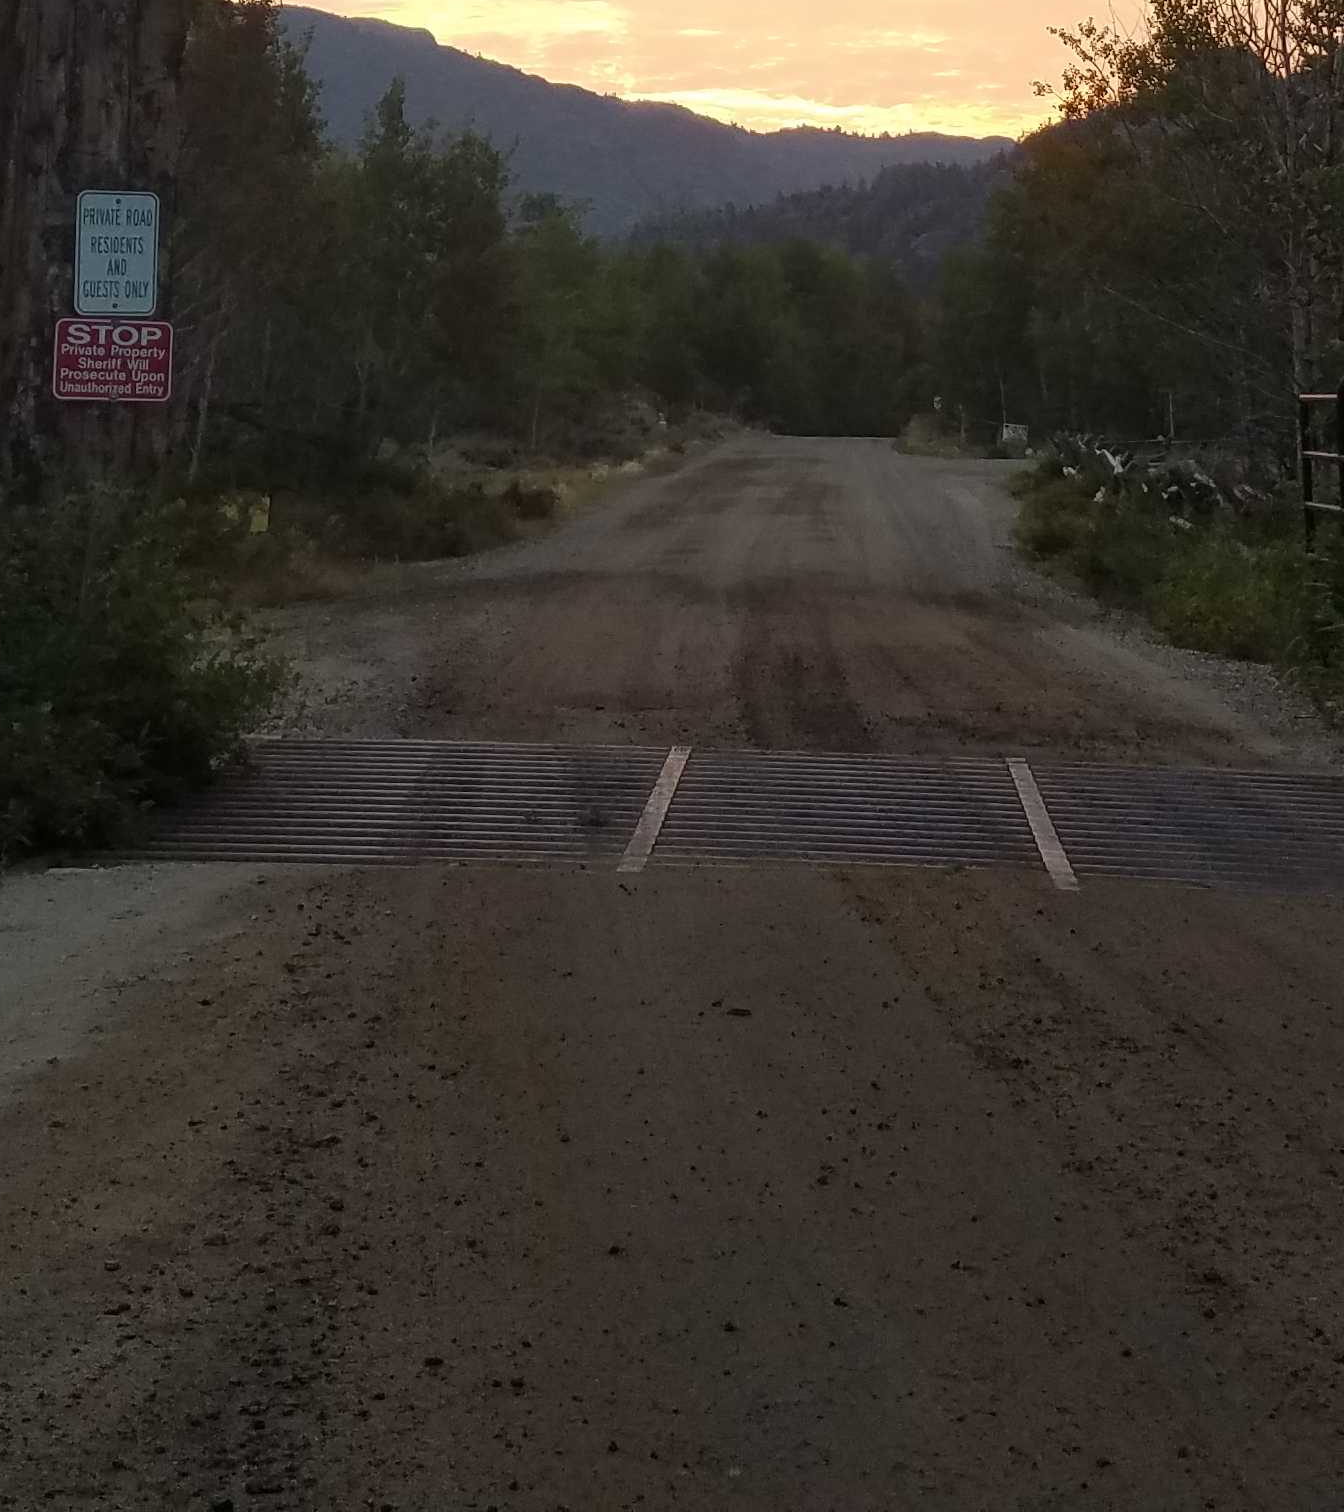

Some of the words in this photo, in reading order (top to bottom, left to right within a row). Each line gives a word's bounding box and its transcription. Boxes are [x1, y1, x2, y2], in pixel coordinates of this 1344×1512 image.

[83, 208, 121, 226] PRIVATE
[126, 209, 153, 227] ROAD
[90, 236, 144, 255] RESIDENTS
[107, 258, 127, 276] AND
[83, 280, 119, 298] GUESTS
[125, 281, 149, 299] ONLY
[67, 323, 163, 346] STOP
[61, 343, 106, 357] Private
[110, 344, 166, 360] Property
[78, 356, 122, 371] Sheriff
[127, 359, 149, 371] Will
[60, 367, 127, 382] Prosecute
[131, 371, 165, 385] Upon
[60, 380, 132, 394] Unauthorized
[135, 383, 164, 397] Entry
